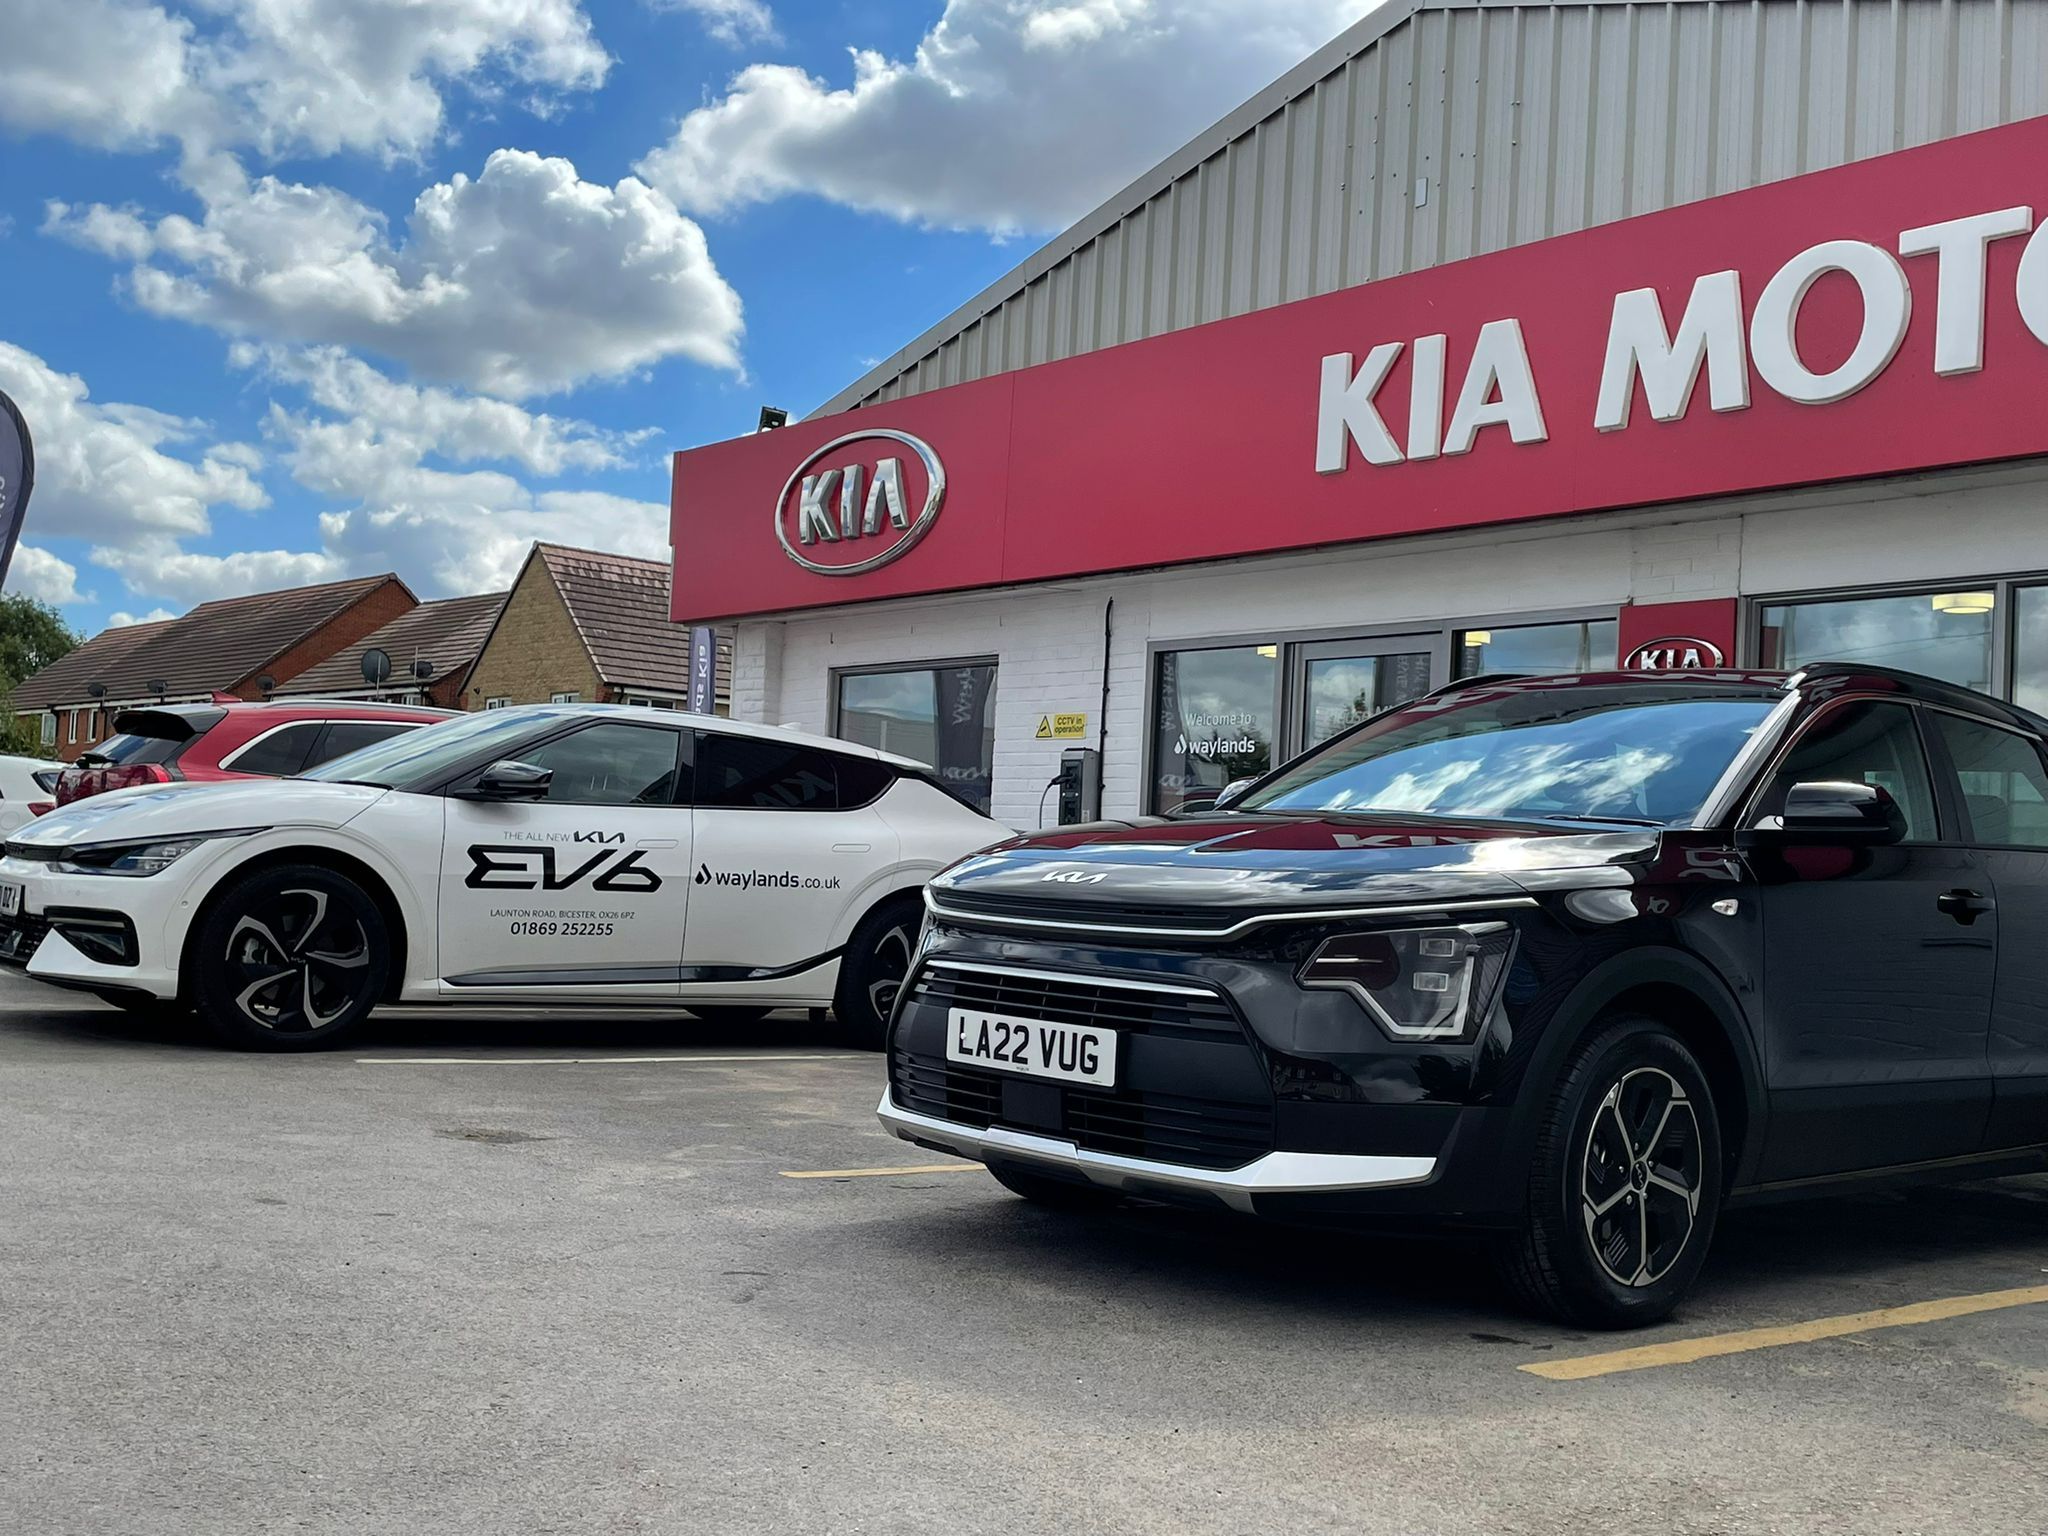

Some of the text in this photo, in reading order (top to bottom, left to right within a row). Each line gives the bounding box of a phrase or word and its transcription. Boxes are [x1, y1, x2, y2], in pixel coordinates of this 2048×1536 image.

[1316, 206, 2048, 475] KIA MOT
[800, 457, 909, 545] KIA
[1640, 647, 1702, 669] KIA
[1055, 725, 1084, 734] operation
[1057, 716, 1083, 725] CCTV in
[1186, 712, 1252, 726] Welcome to
[1189, 736, 1256, 757] waylands
[503, 831, 523, 841] THE
[526, 832, 543, 841] ALL
[546, 832, 570, 842] NEW
[464, 844, 663, 892] EV6
[715, 869, 841, 891] waylands.co.uk
[490, 909, 531, 918] LAUNTON
[532, 910, 557, 919] ROAD,
[598, 911, 619, 919] OX26
[620, 911, 635, 920] 6PZ
[510, 922, 614, 936] 01869 252255
[958, 1016, 1100, 1075] LA22 VUG
